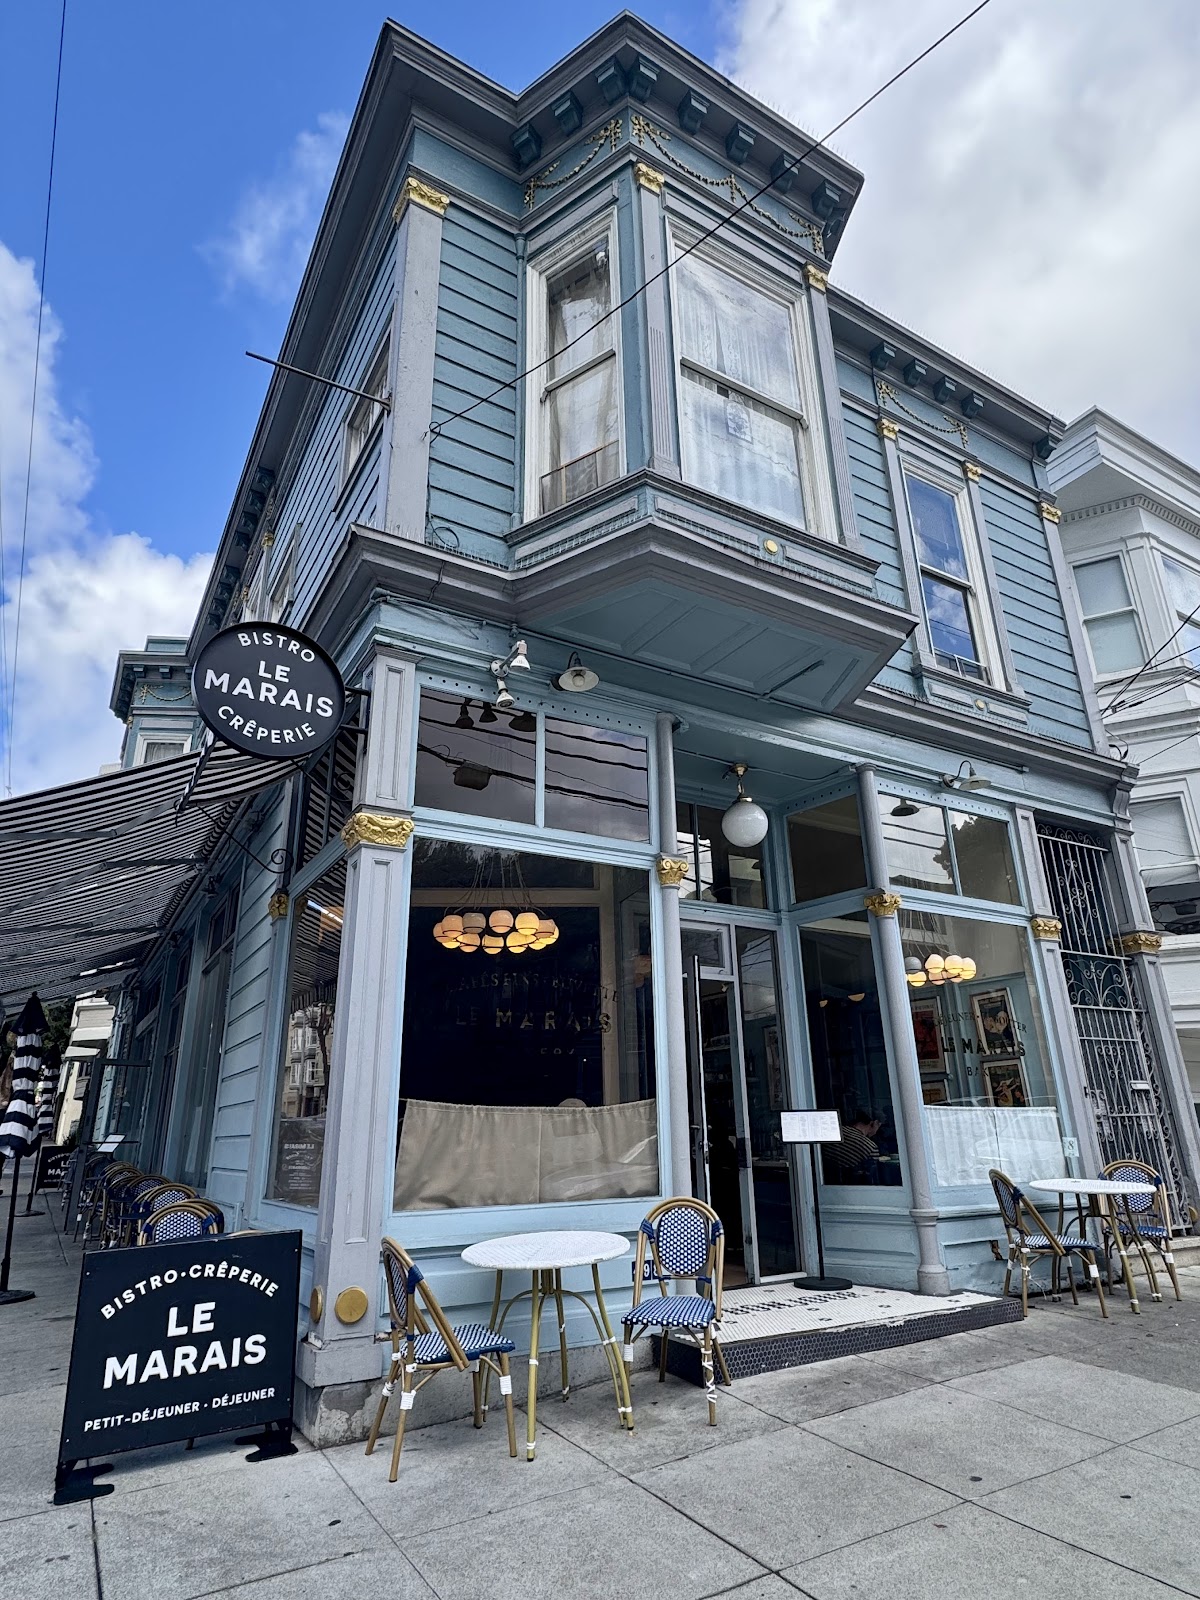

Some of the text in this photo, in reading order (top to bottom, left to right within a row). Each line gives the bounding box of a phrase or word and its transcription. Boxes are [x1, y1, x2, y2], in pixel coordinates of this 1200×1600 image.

[237, 631, 315, 662] BISTRO
[258, 660, 291, 683] LE
[204, 669, 333, 718] MARAIS
[218, 706, 316, 744] CRÊPERIE
[495, 1007, 611, 1033] MARAIS
[633, 1263, 658, 1278] 98
[166, 1302, 216, 1337] LE
[103, 1334, 267, 1389] MARAIS
[84, 1387, 275, 1432] PETIT-DÉJEUNER DÉJEUNER
